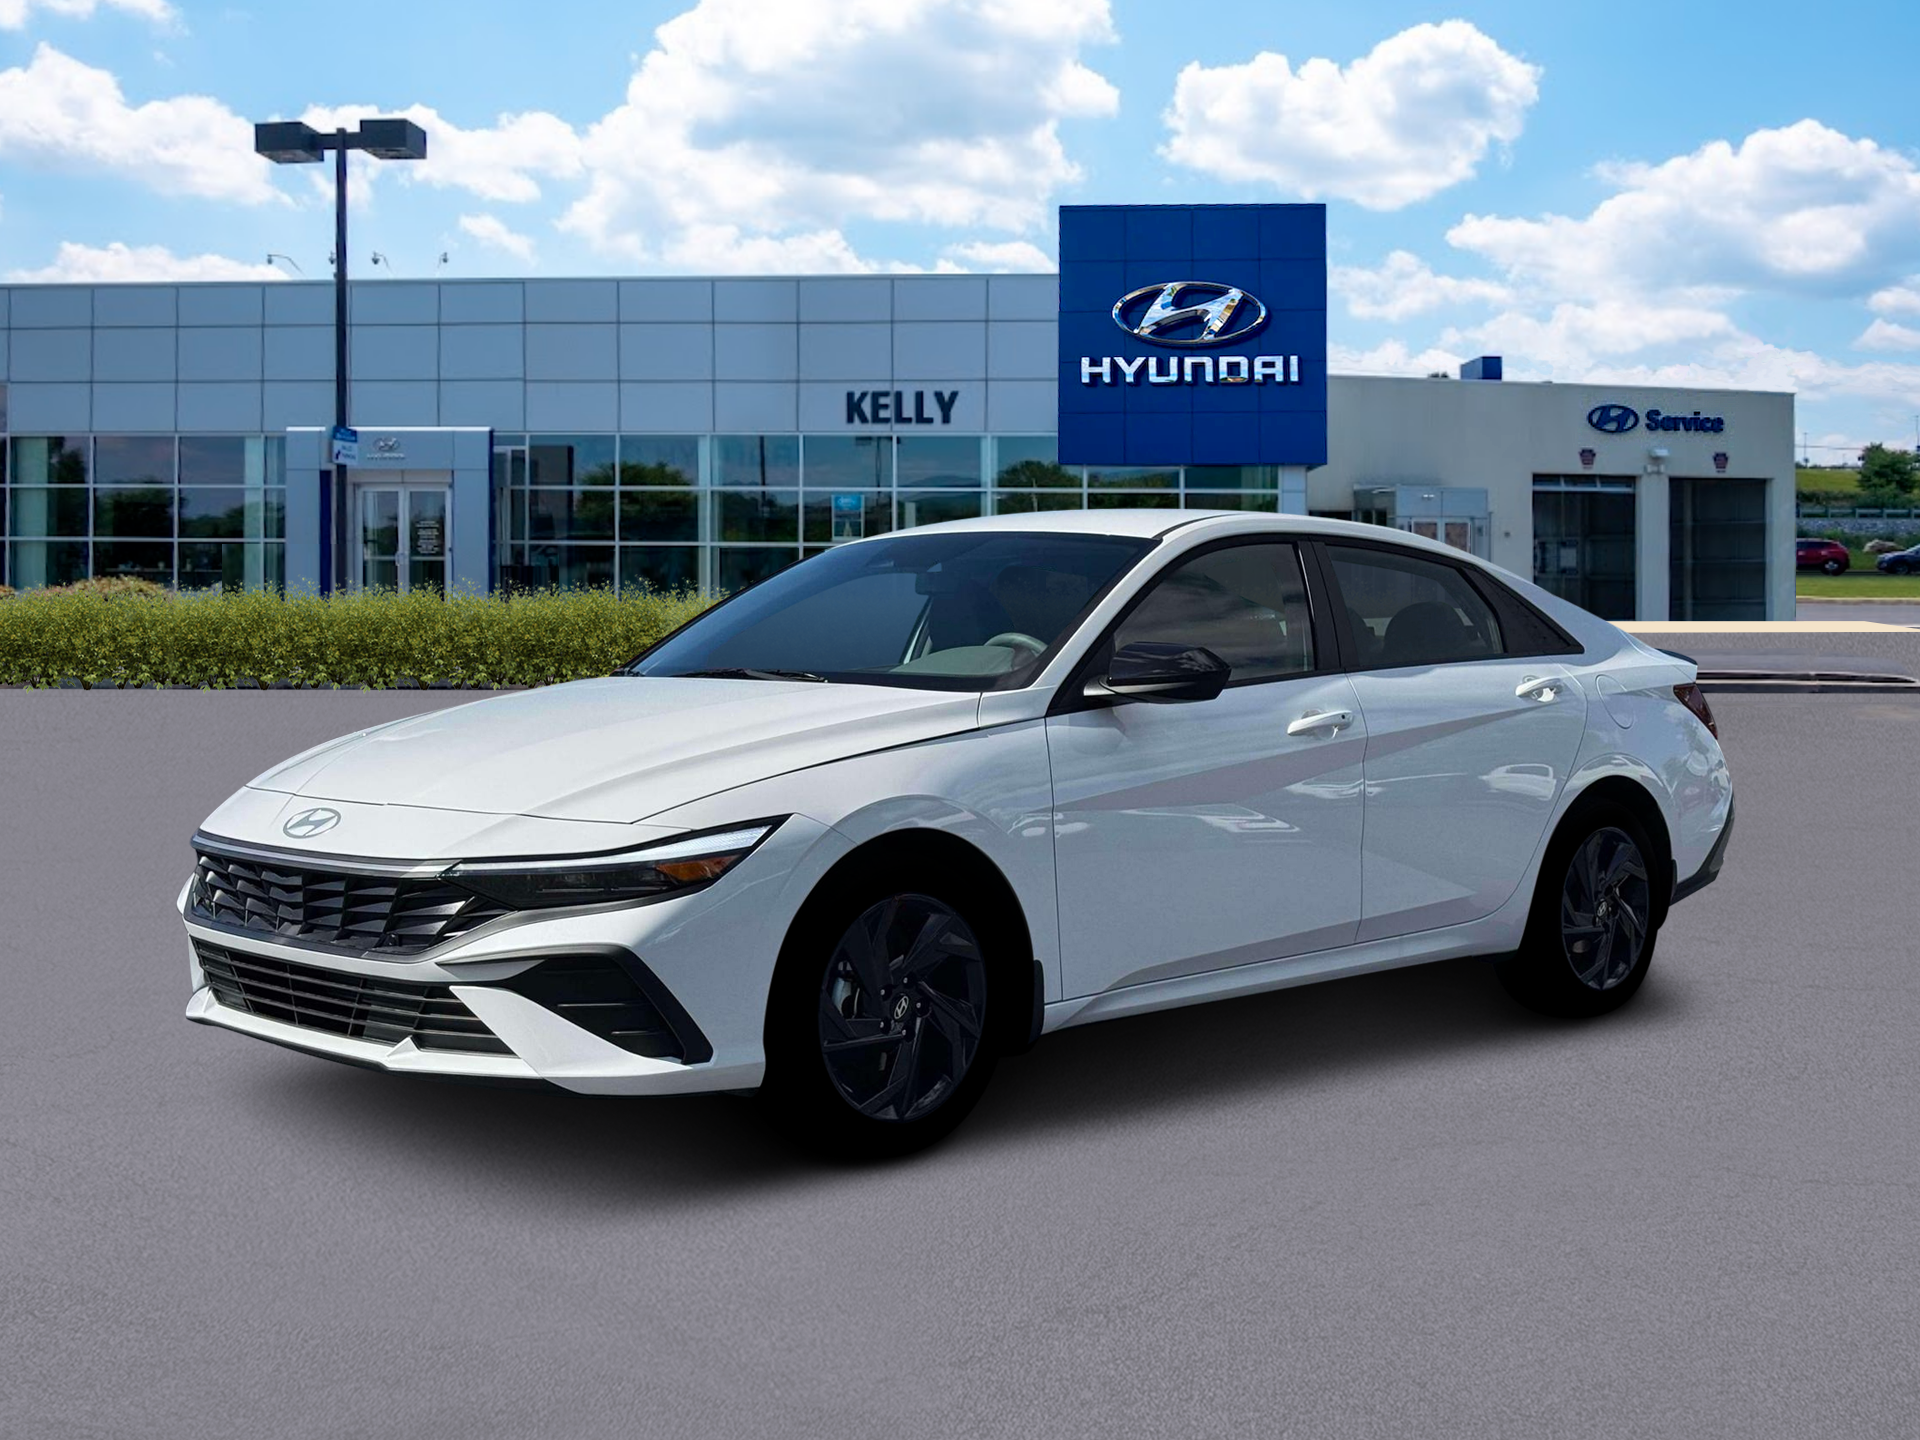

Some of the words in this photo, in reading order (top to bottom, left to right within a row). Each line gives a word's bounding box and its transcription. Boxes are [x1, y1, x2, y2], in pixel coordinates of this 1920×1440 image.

[1080, 355, 1299, 384] HYUNDAI
[846, 390, 959, 424] KELLY
[1645, 409, 1725, 433] Service
